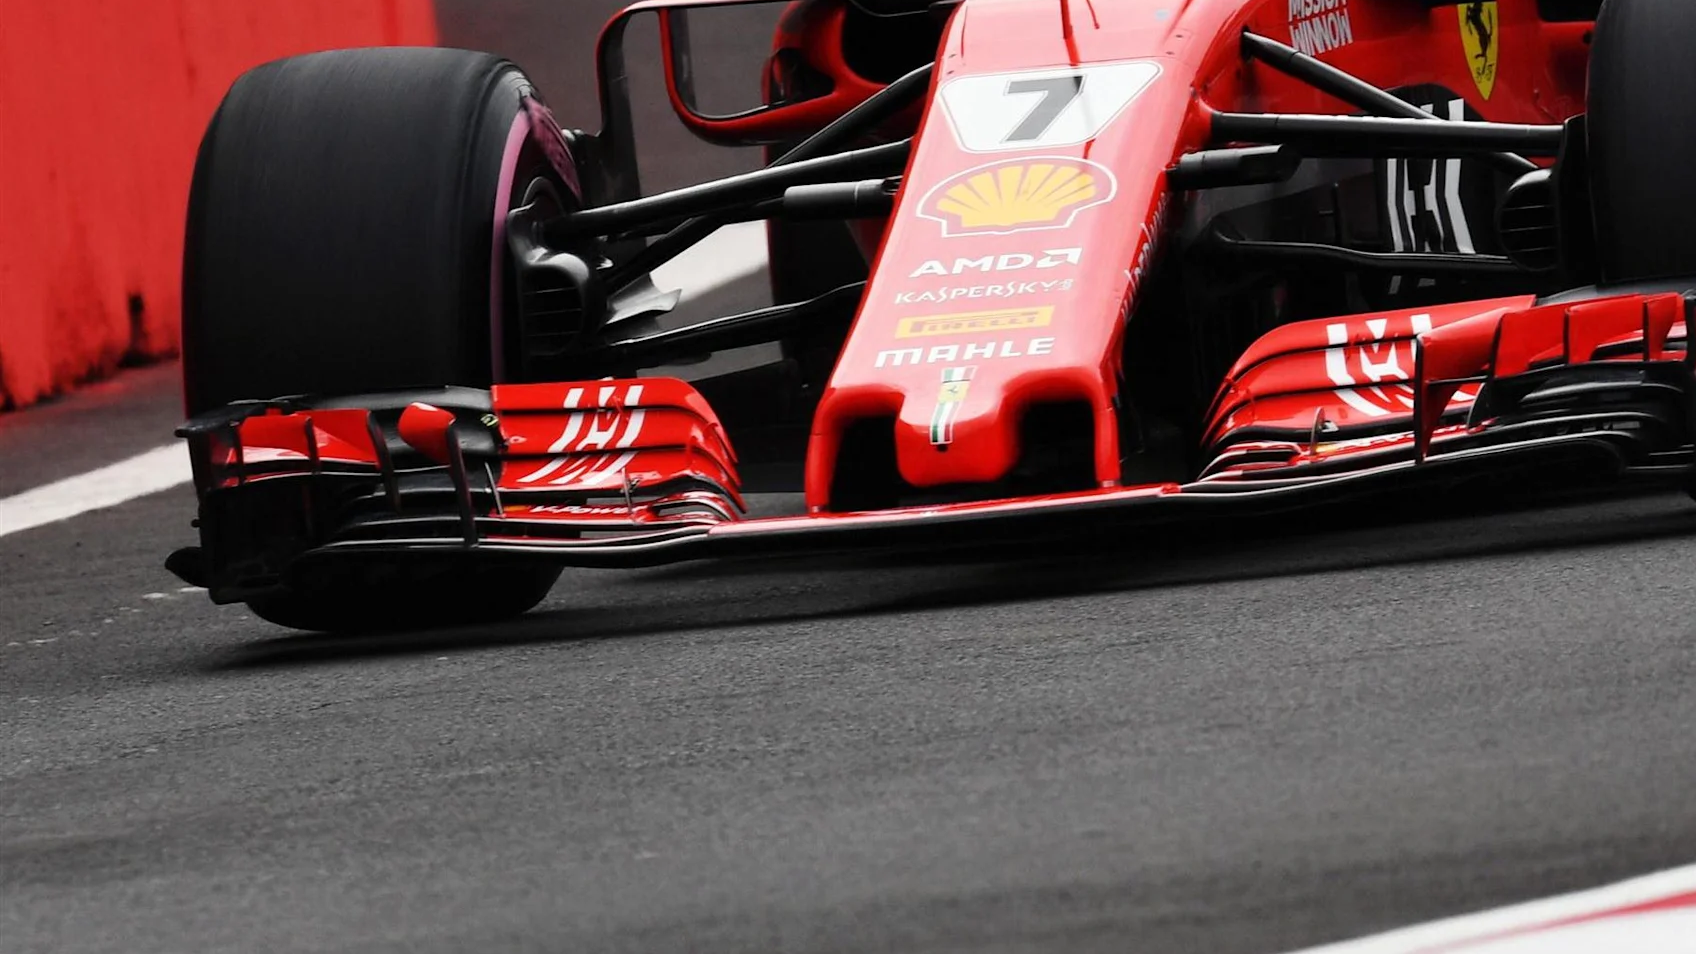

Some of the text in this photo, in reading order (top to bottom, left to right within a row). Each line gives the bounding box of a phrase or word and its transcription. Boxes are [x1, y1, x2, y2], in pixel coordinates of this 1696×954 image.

[1289, 8, 1353, 57] WINNOW
[1003, 74, 1084, 142] 7
[908, 252, 1035, 278] AMD
[894, 279, 1058, 305] KASPERSKY
[909, 311, 1040, 334] PIRELLI
[874, 337, 1056, 369] MAHLE
